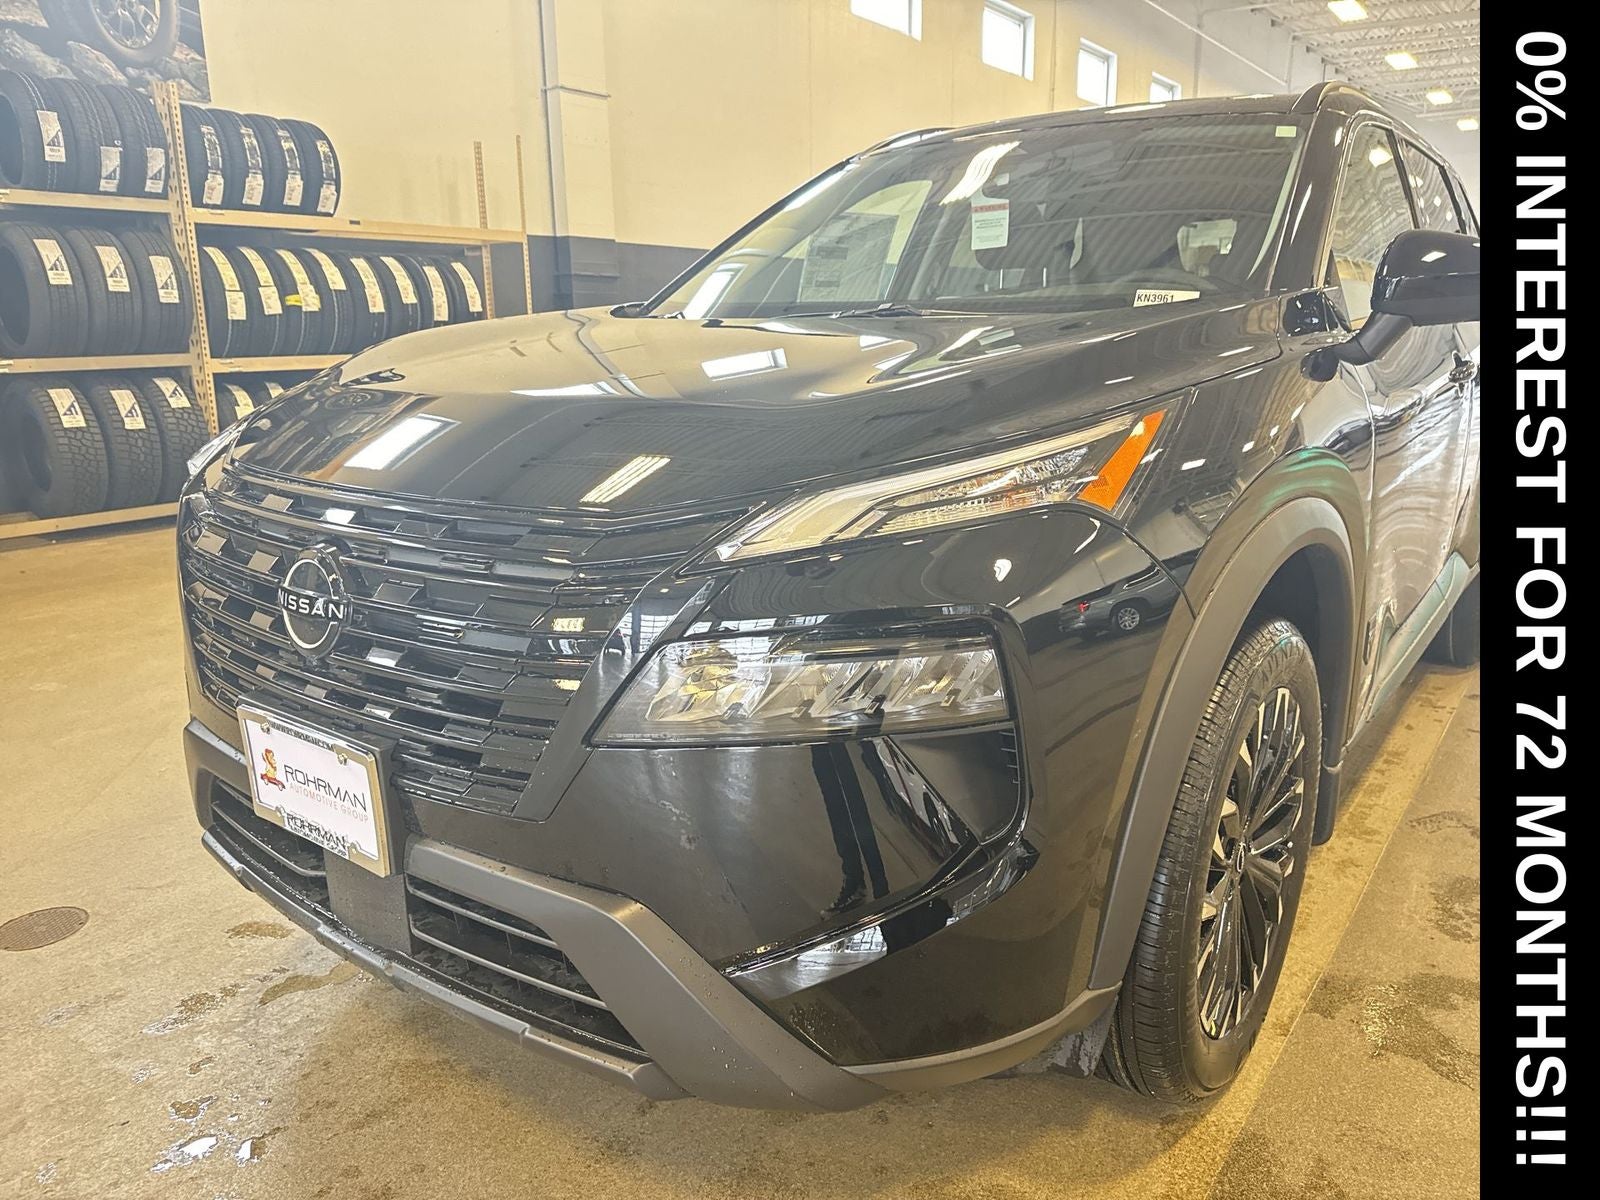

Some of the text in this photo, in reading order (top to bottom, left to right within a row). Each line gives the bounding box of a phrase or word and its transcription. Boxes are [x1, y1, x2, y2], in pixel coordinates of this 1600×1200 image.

[1136, 293, 1174, 303] KN3961
[278, 588, 344, 619] NISSAN
[284, 764, 367, 812] ROHRMAN
[289, 781, 368, 823] AUTOMOTIVE GROUP
[286, 812, 347, 850] ROHRMAN
